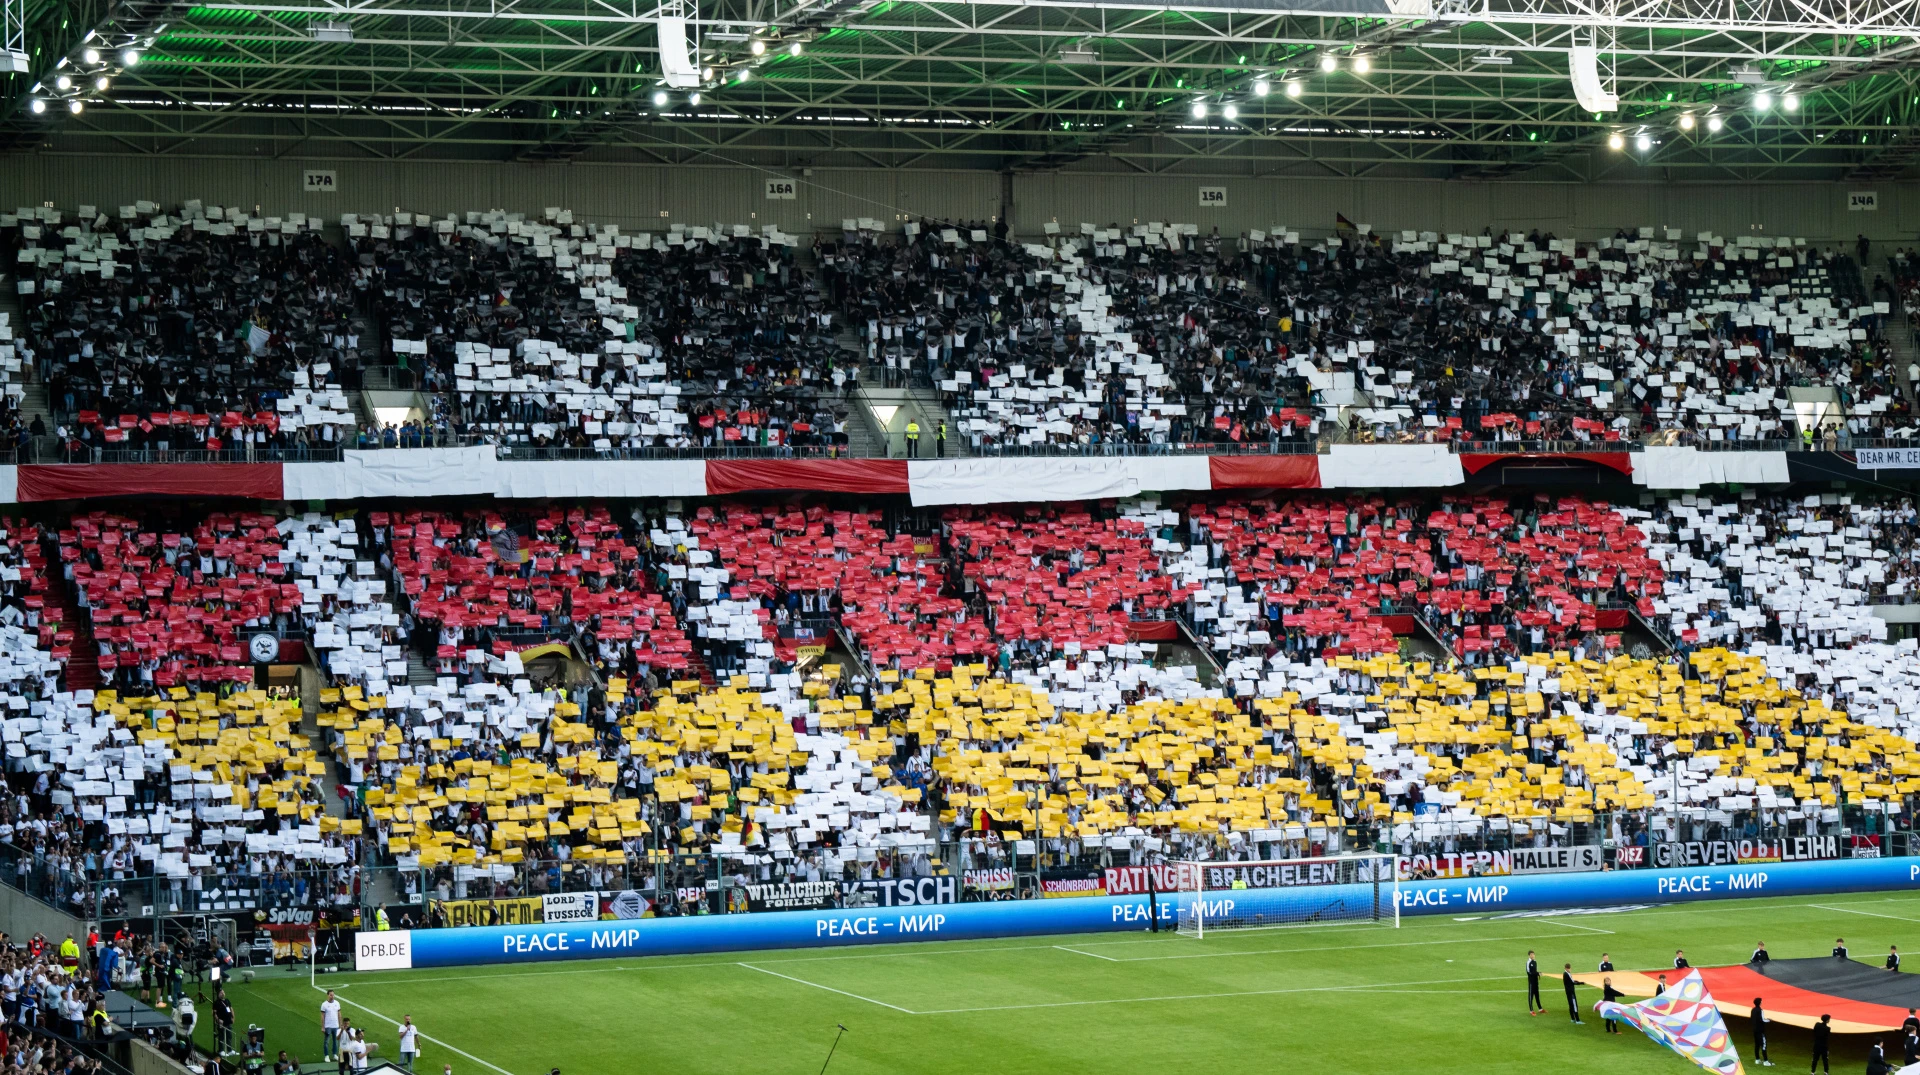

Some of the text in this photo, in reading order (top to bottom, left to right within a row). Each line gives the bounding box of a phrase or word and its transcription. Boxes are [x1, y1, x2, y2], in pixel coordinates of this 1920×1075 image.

[308, 175, 332, 185] 17A
[769, 184, 793, 194] 16A
[1203, 191, 1224, 201] 15A
[1851, 196, 1874, 206] 14A
[1860, 451, 1884, 464] DEAR
[1886, 450, 1904, 463] MR.
[1656, 840, 1738, 866] GREVEN
[1781, 836, 1837, 860] LEIHA
[1398, 849, 1510, 880] GOLTERN
[1513, 850, 1568, 870] HALLE
[1583, 849, 1598, 866] S.
[1105, 864, 1204, 893] RATINGEN
[1210, 863, 1336, 888] BRACHELEN
[1658, 875, 1711, 893] PEACE
[745, 881, 836, 901] WILLICHER
[842, 876, 955, 908] KETSCH
[1045, 878, 1100, 893] SCHÖNBRONN
[546, 895, 576, 905] LORD
[765, 897, 825, 908] FOHLEN
[1393, 888, 1448, 907] PEACE
[269, 907, 314, 926] SpVgg
[547, 908, 594, 920] FUSSECK
[816, 917, 878, 937] PEACE
[361, 943, 406, 957] DFB.DE
[504, 932, 569, 953] PEACE
